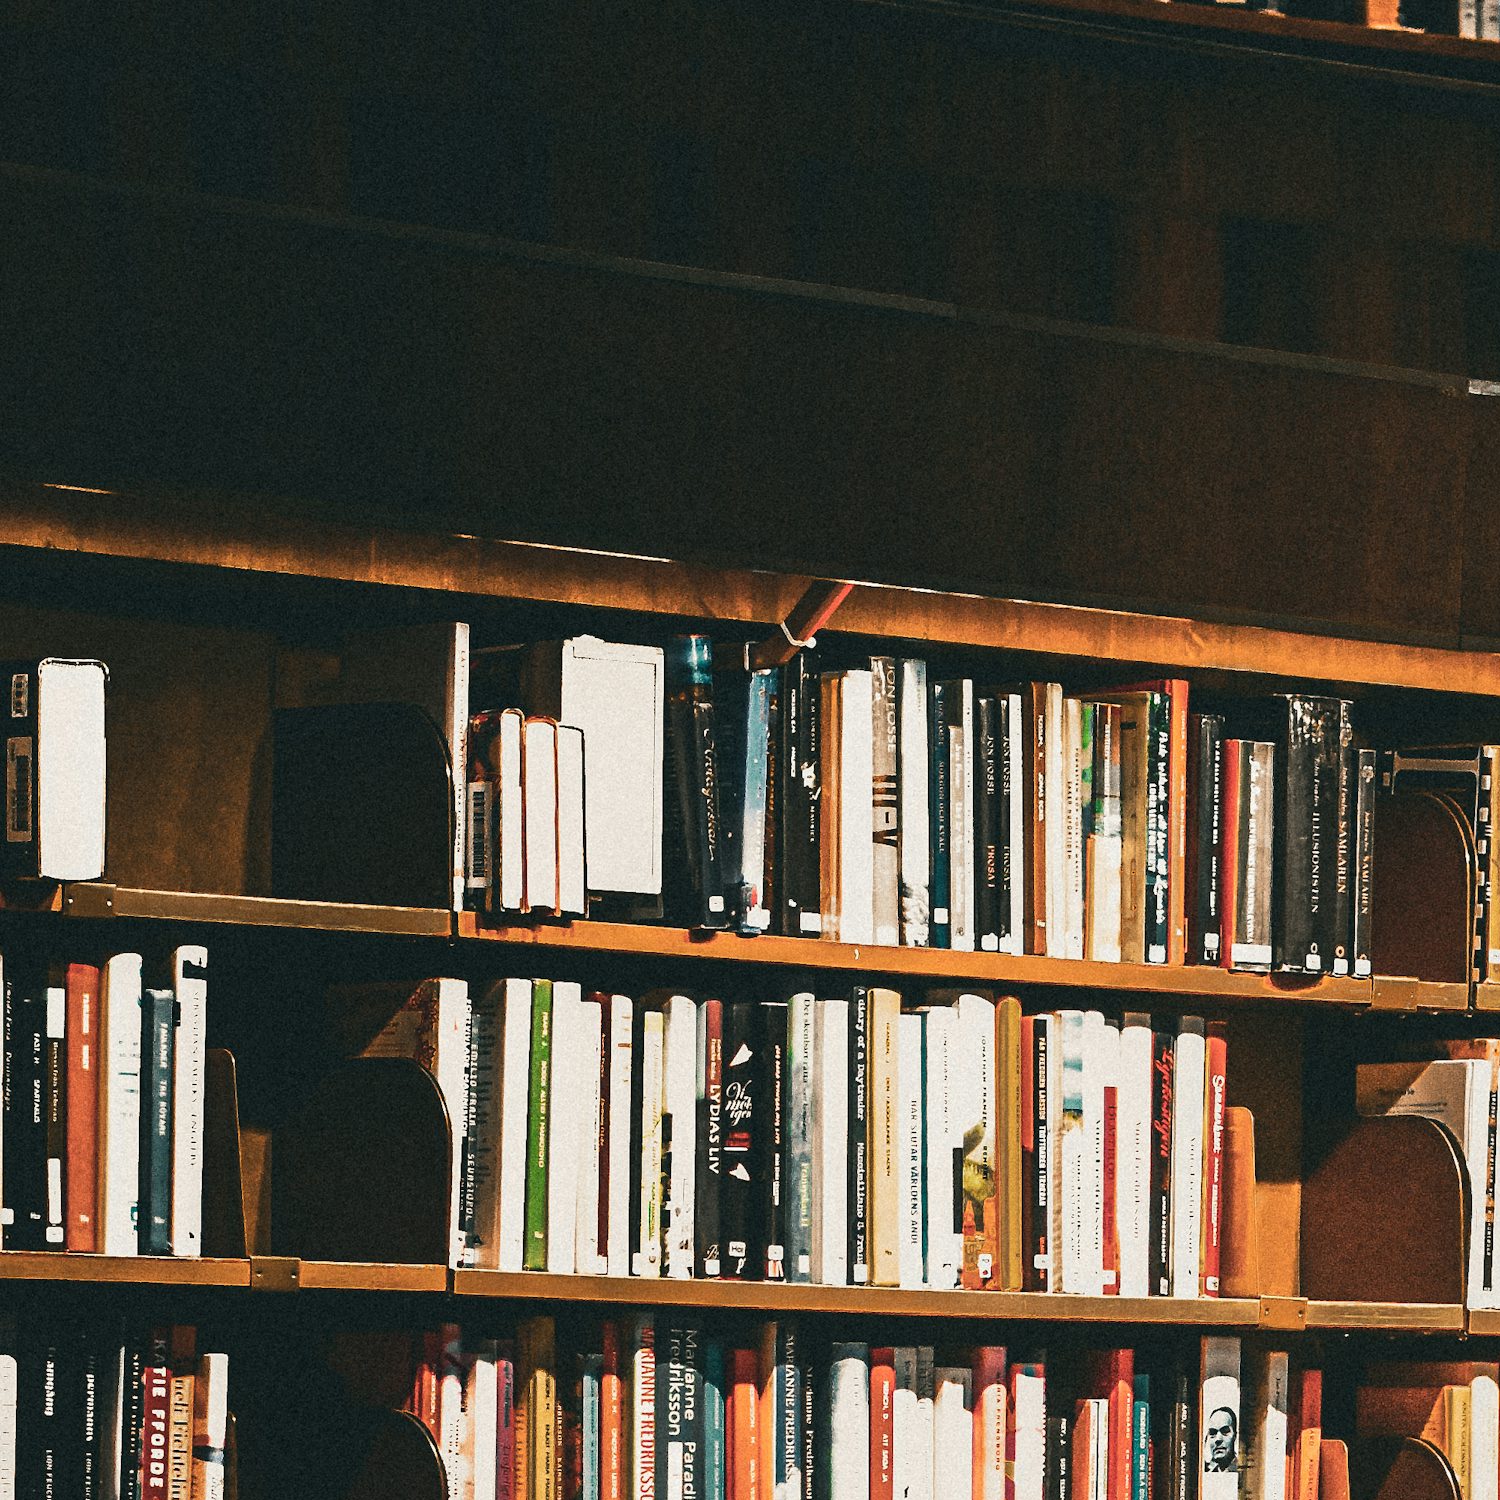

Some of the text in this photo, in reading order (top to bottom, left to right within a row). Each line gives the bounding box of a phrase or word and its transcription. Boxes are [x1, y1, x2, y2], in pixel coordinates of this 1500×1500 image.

[886, 663, 896, 754] JON FOSSE
[987, 733, 995, 878] JON FOSSE PROSA
[1337, 819, 1347, 894] SAMLAREN
[856, 999, 865, 1032] diary
[857, 1035, 865, 1050] of
[708, 1083, 721, 1175] LYDIAS LIV
[856, 1063, 866, 1122] Daytrader
